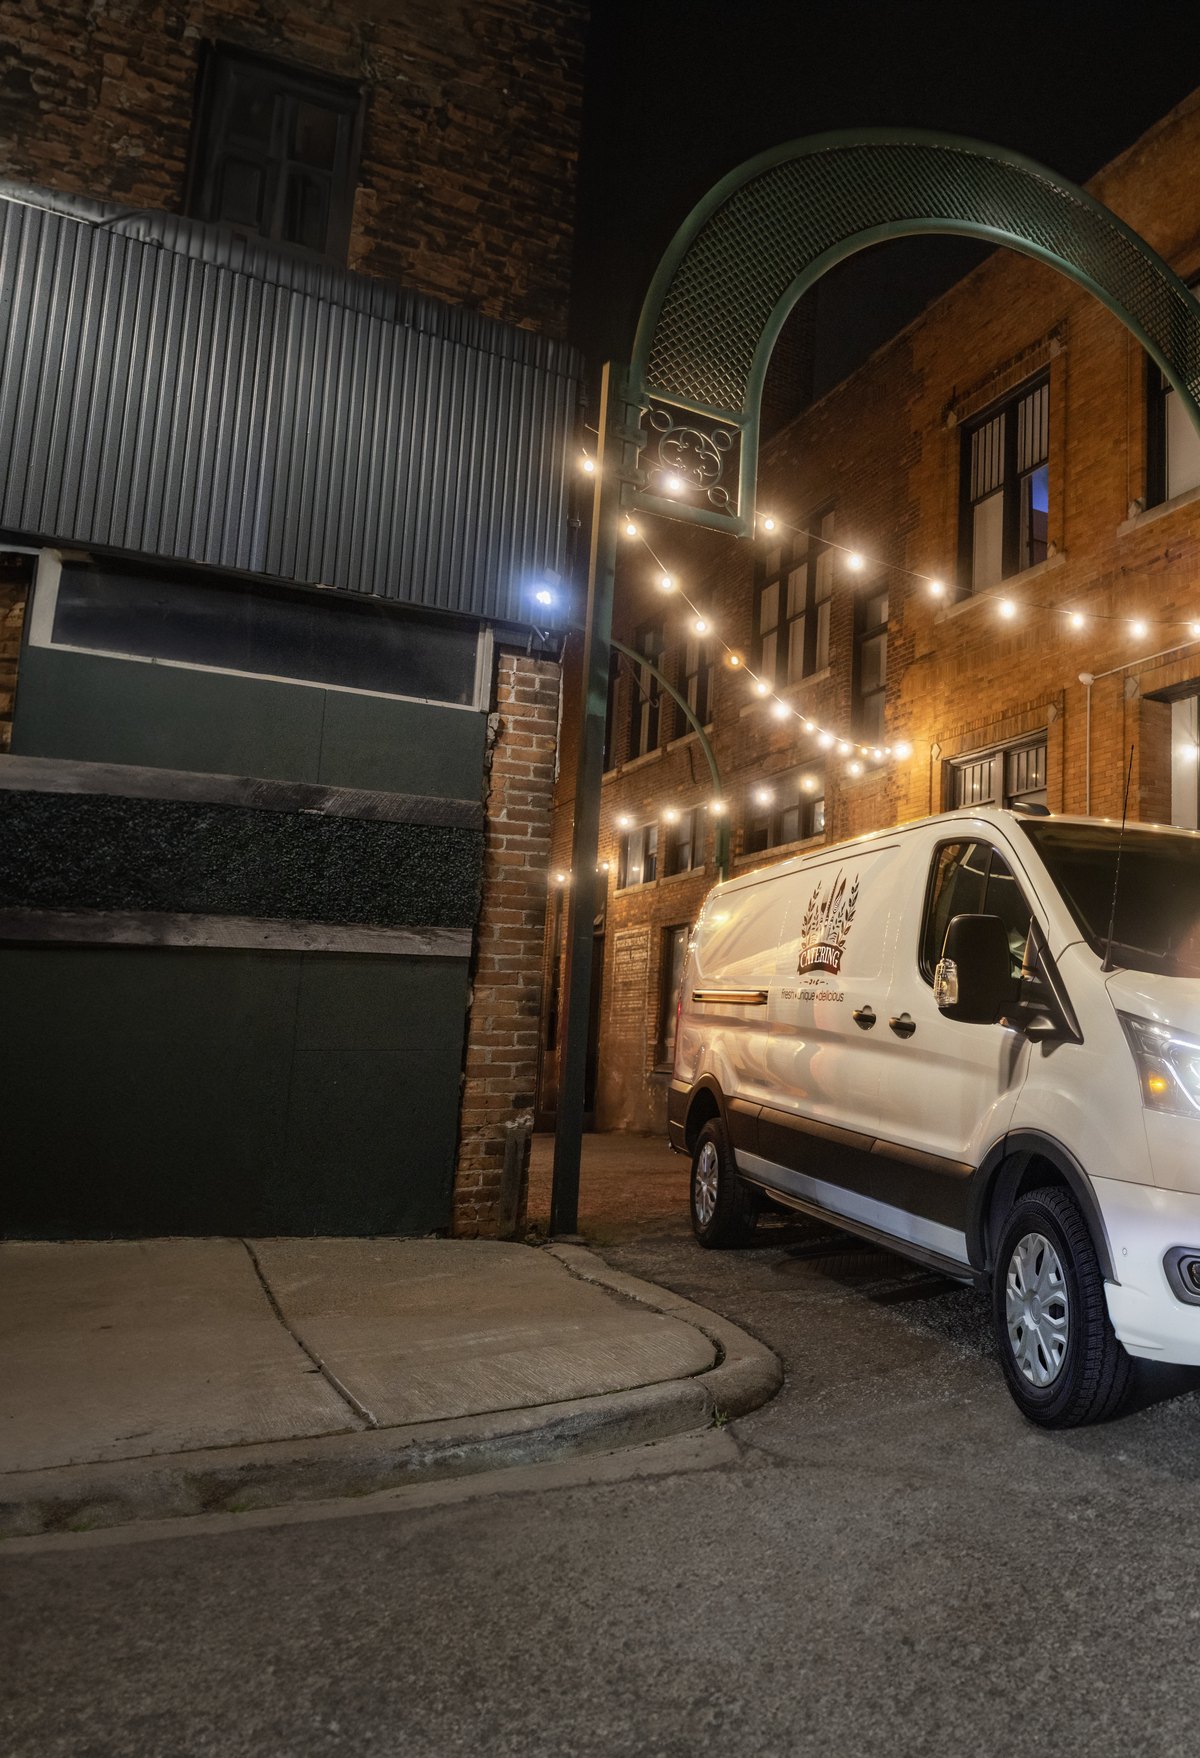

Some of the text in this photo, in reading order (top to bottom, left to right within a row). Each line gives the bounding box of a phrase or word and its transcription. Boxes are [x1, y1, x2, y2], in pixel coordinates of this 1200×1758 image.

[800, 946, 840, 968] CATERING
[781, 988, 844, 1003] fresh unique delicious
